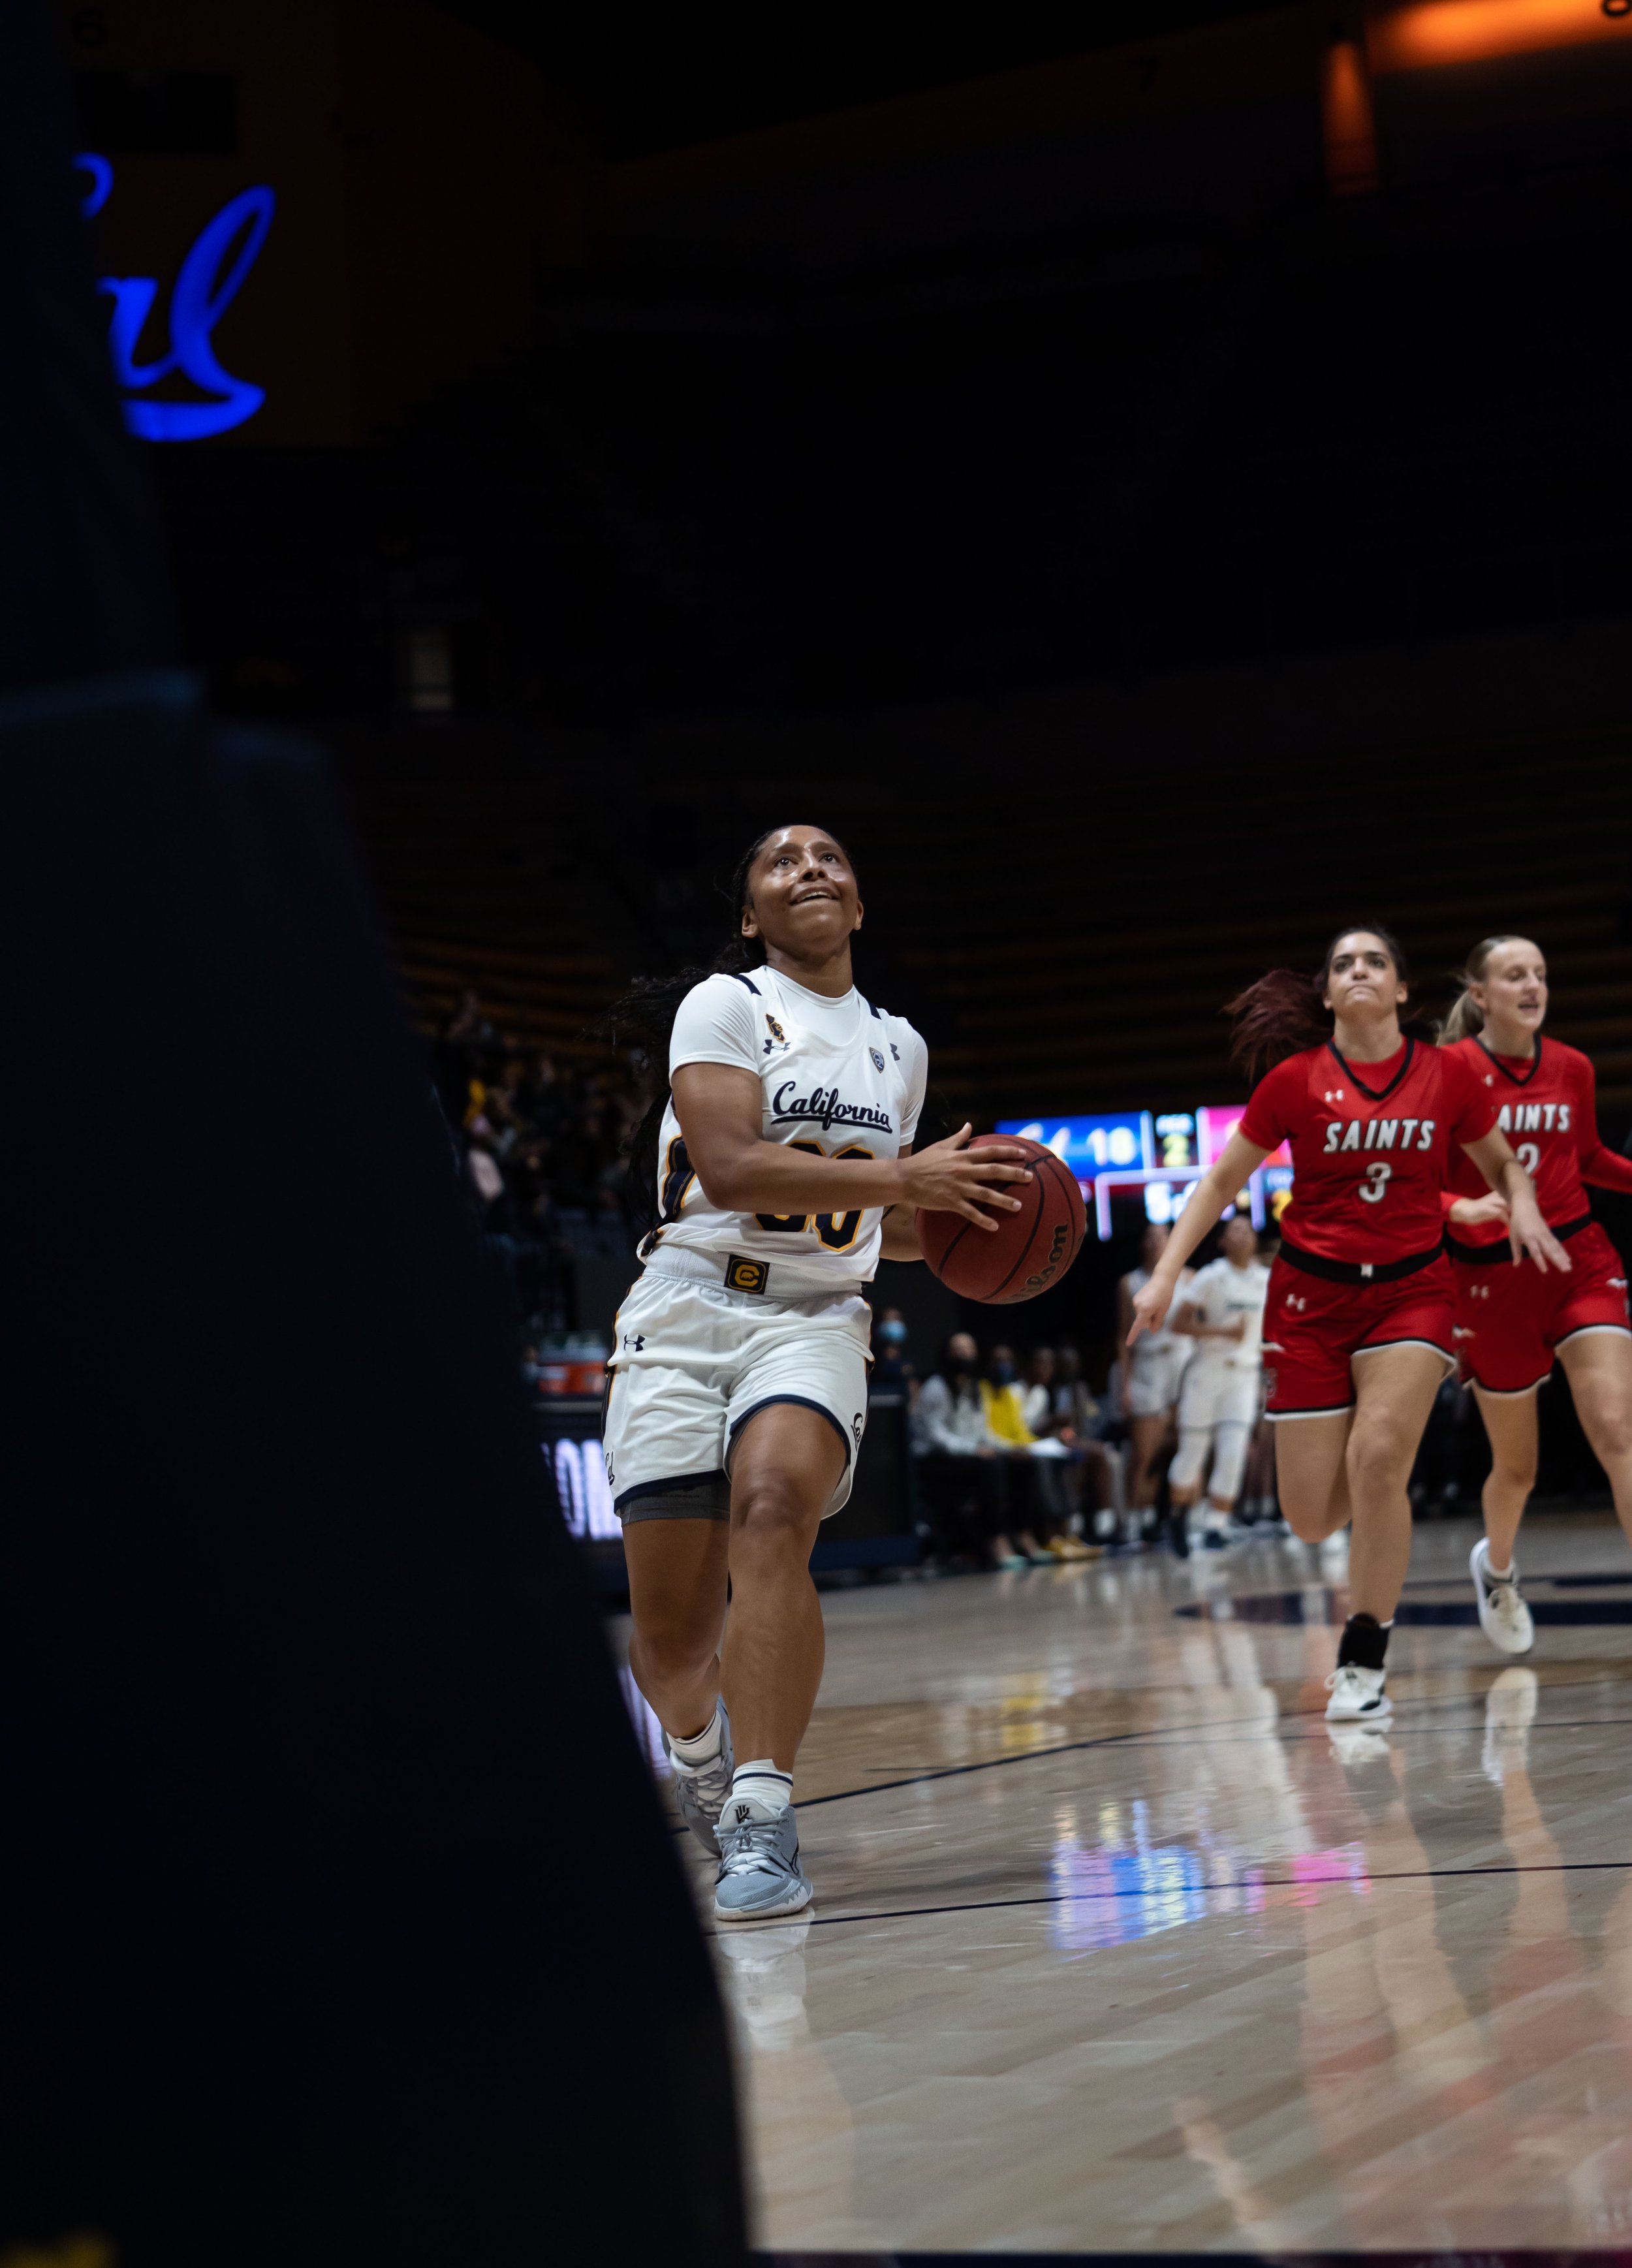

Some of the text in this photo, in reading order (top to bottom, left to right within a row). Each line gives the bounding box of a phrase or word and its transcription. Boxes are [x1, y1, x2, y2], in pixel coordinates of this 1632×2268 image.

[771, 1080, 892, 1134] California
[1496, 1102, 1571, 1133] AINTS
[1323, 1118, 1436, 1154] SAINTS
[1358, 1161, 1393, 1204] 3
[735, 1264, 760, 1287] C
